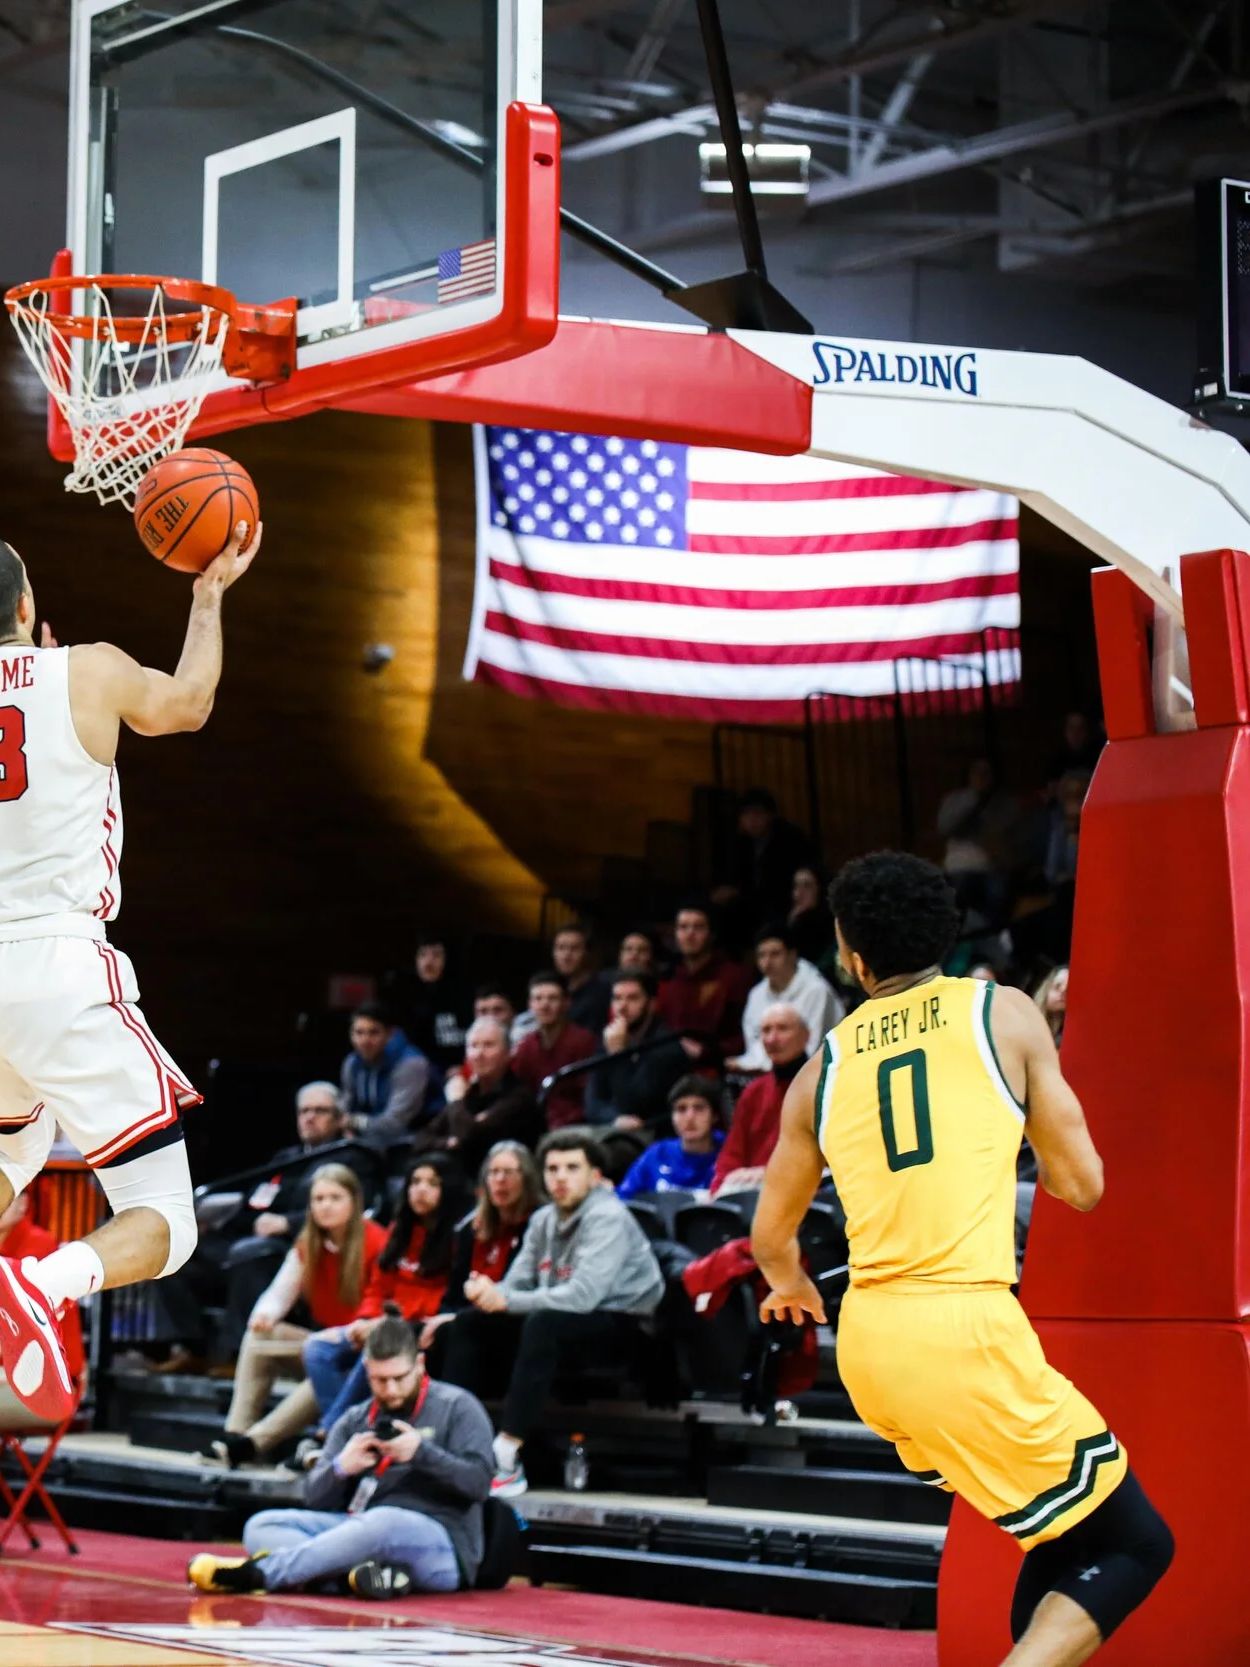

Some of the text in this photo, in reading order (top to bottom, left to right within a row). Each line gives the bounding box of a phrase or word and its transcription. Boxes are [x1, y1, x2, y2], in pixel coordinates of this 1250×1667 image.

[812, 341, 978, 396] SPALDING
[154, 496, 189, 532] THE
[855, 996, 948, 1053] CAREY JR.
[877, 1048, 934, 1173] 0
